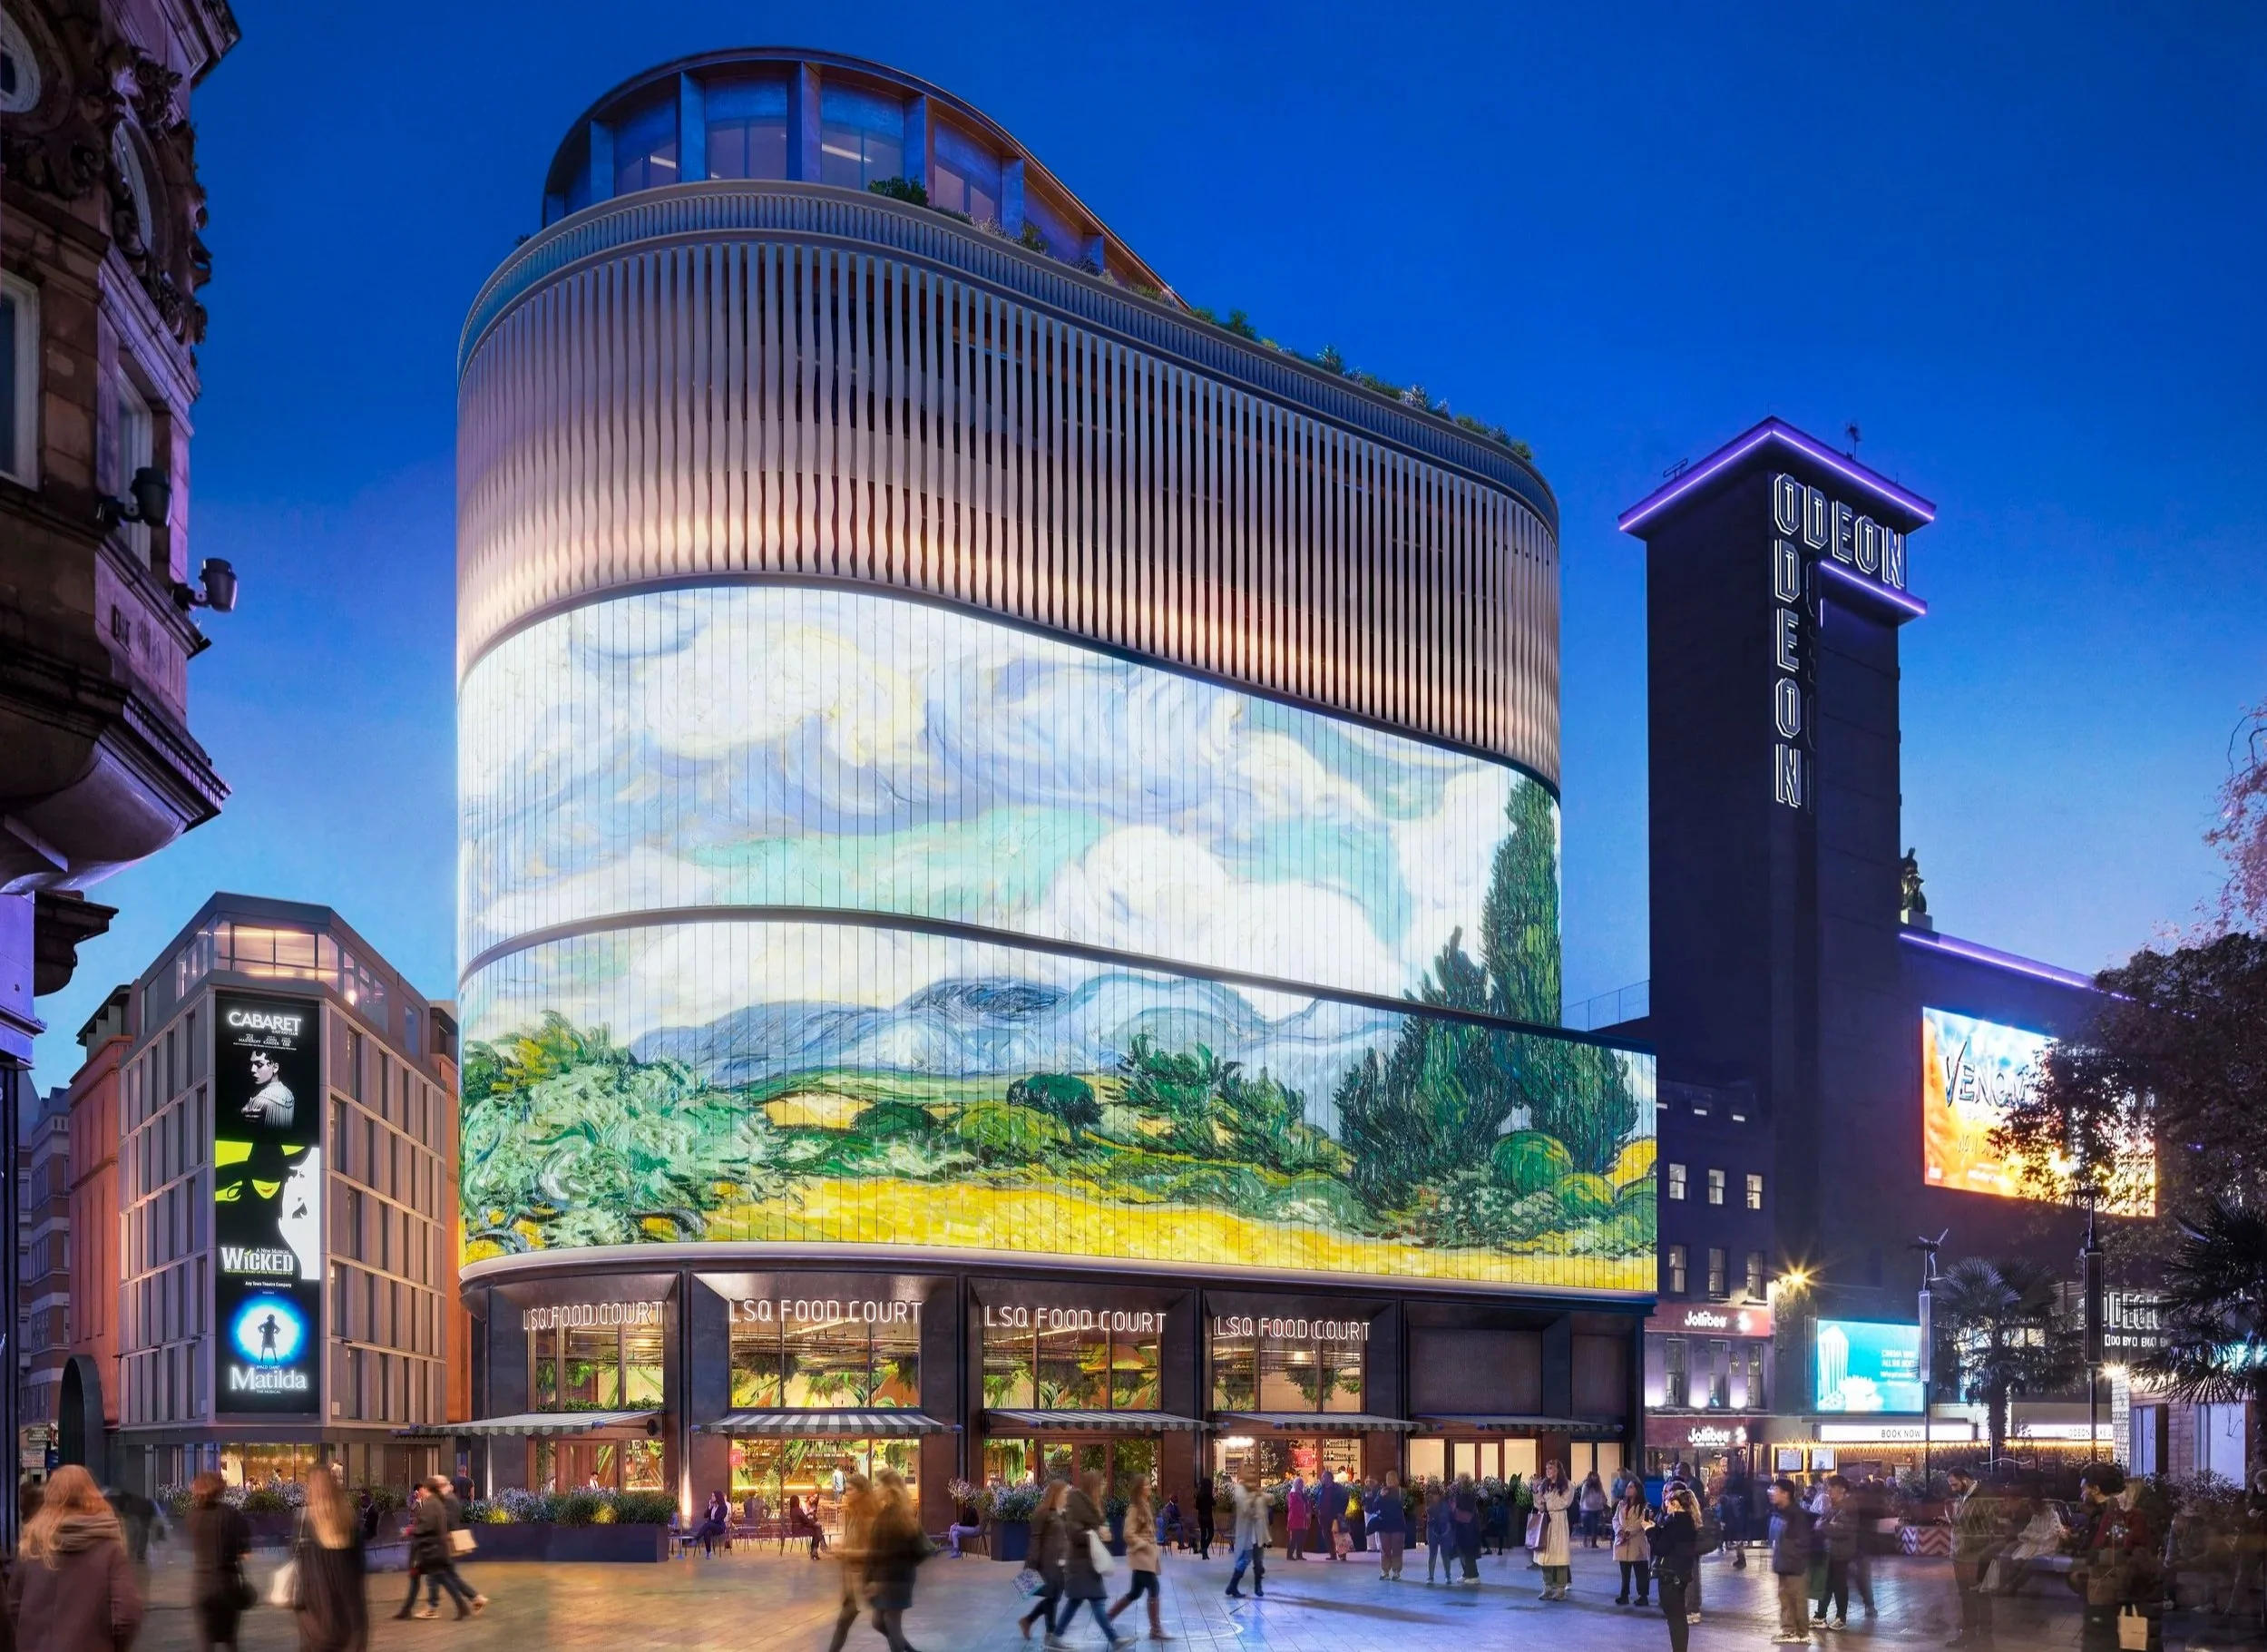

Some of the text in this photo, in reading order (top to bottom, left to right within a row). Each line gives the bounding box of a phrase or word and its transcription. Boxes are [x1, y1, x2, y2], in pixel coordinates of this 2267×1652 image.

[1774, 473, 1905, 589] ODEON
[228, 1012, 302, 1034] CABARET
[523, 1301, 663, 1330] LSQ FOOD COURT
[728, 1299, 923, 1324] LSQ FOOD COURT
[984, 1305, 1167, 1334] LSQ FOOD COURT
[1684, 1310, 1727, 1327] Jollibee
[1215, 1316, 1371, 1341] LSQ FOOD COURT
[231, 1366, 308, 1390] Matilda
[1687, 1426, 1730, 1442] Jollibee
[1881, 1429, 1921, 1438] BOOK NOW
